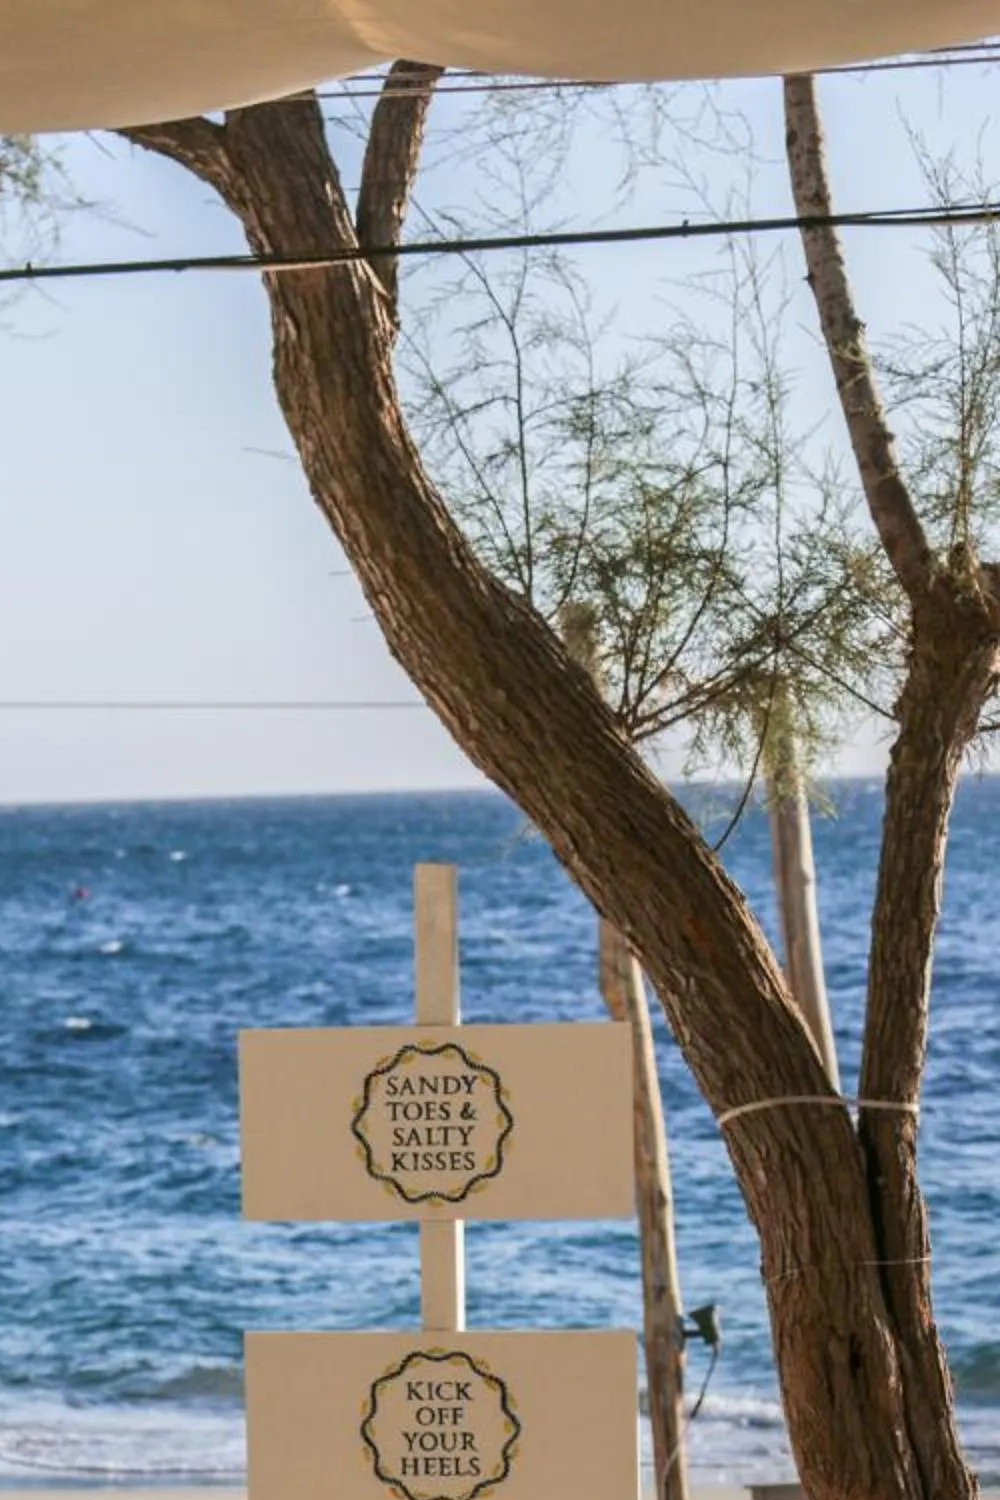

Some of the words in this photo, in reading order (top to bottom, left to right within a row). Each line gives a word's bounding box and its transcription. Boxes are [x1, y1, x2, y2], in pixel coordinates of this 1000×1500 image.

[386, 1076, 478, 1096] SANDY
[386, 1101, 451, 1121] TOES
[460, 1101, 478, 1121] &
[393, 1126, 474, 1147] SALTY
[391, 1152, 476, 1172] KISSES
[406, 1381, 474, 1401] KICK
[415, 1407, 464, 1426] OFF
[402, 1431, 478, 1452] YOUR
[401, 1457, 481, 1477] HEELS
